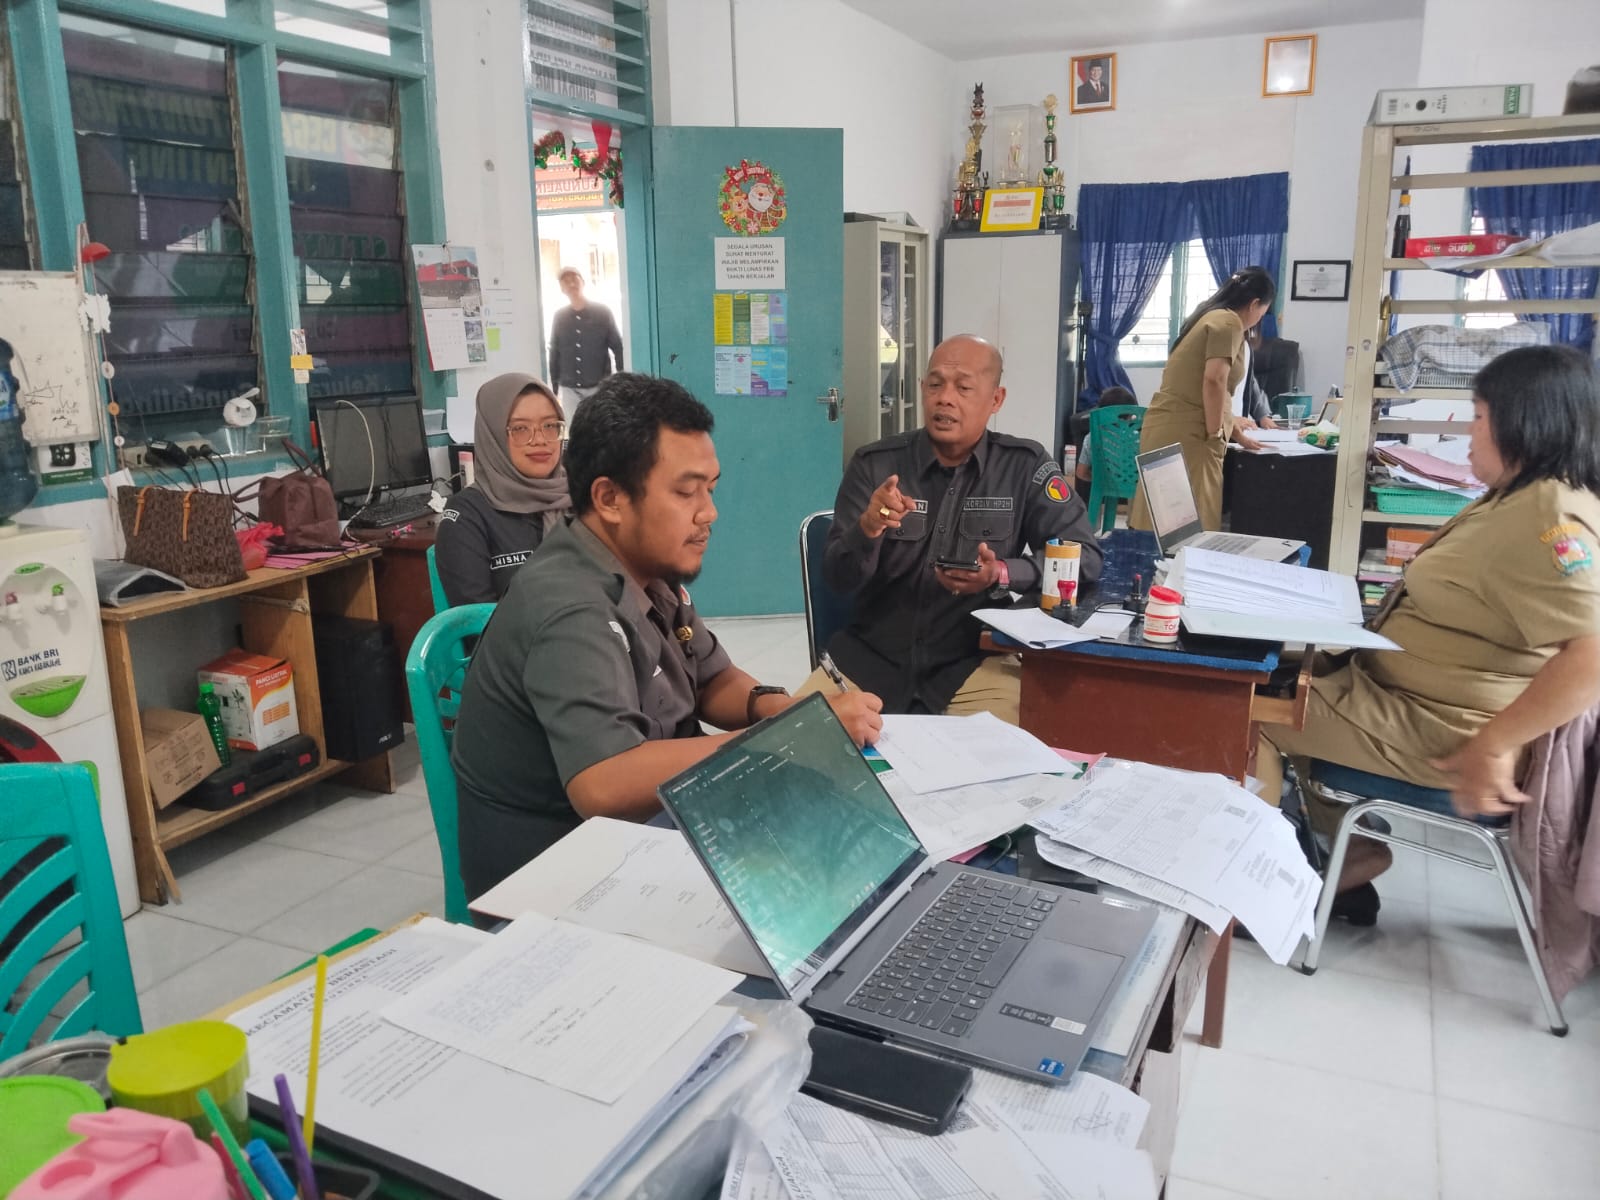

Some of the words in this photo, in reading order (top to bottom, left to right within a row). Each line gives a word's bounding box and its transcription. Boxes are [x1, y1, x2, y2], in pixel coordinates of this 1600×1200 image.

[17, 651, 41, 666] BANK
[43, 648, 59, 659] BRI
[328, 948, 399, 986] BERASTAGI
